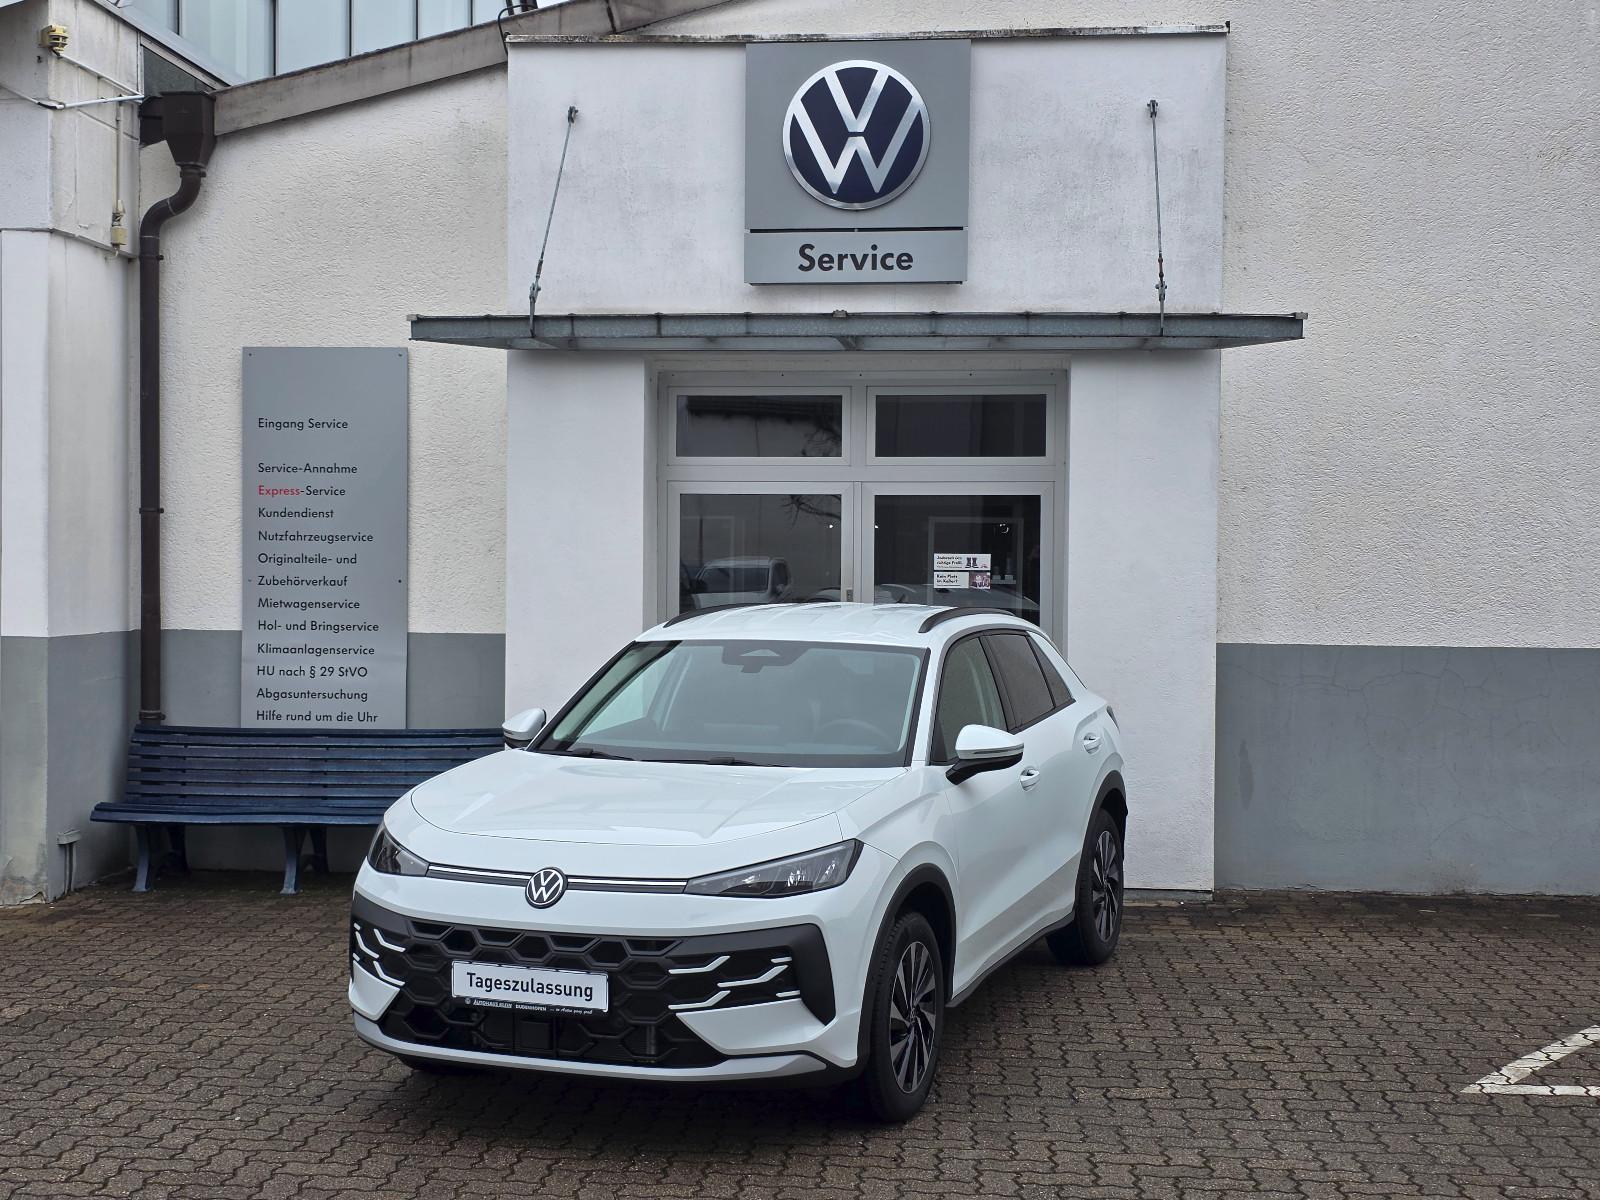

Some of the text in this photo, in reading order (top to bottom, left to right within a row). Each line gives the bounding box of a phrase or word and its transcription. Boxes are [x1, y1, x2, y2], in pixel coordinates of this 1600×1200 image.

[798, 243, 914, 272] Service
[258, 417, 348, 431] Eingang Service
[258, 462, 358, 474] Service-Annahme
[258, 485, 346, 498] Express-Service
[258, 507, 334, 519] Kundendienst
[258, 531, 374, 545] Nutzfahrzeugservice
[258, 552, 357, 566] Originalteile- und
[257, 575, 348, 587] Zubehörverkauf
[257, 598, 360, 611] Mietwagenservice
[258, 620, 379, 633] Hol- und Bringservice
[257, 643, 375, 657] Klimaanlagenservice
[256, 665, 368, 679] HU nach § 29 StVO
[256, 687, 368, 702] Abgasuntersuchung
[256, 710, 379, 723] Hilfe rund um die Uhr
[466, 971, 594, 1001] Tageszulassung
